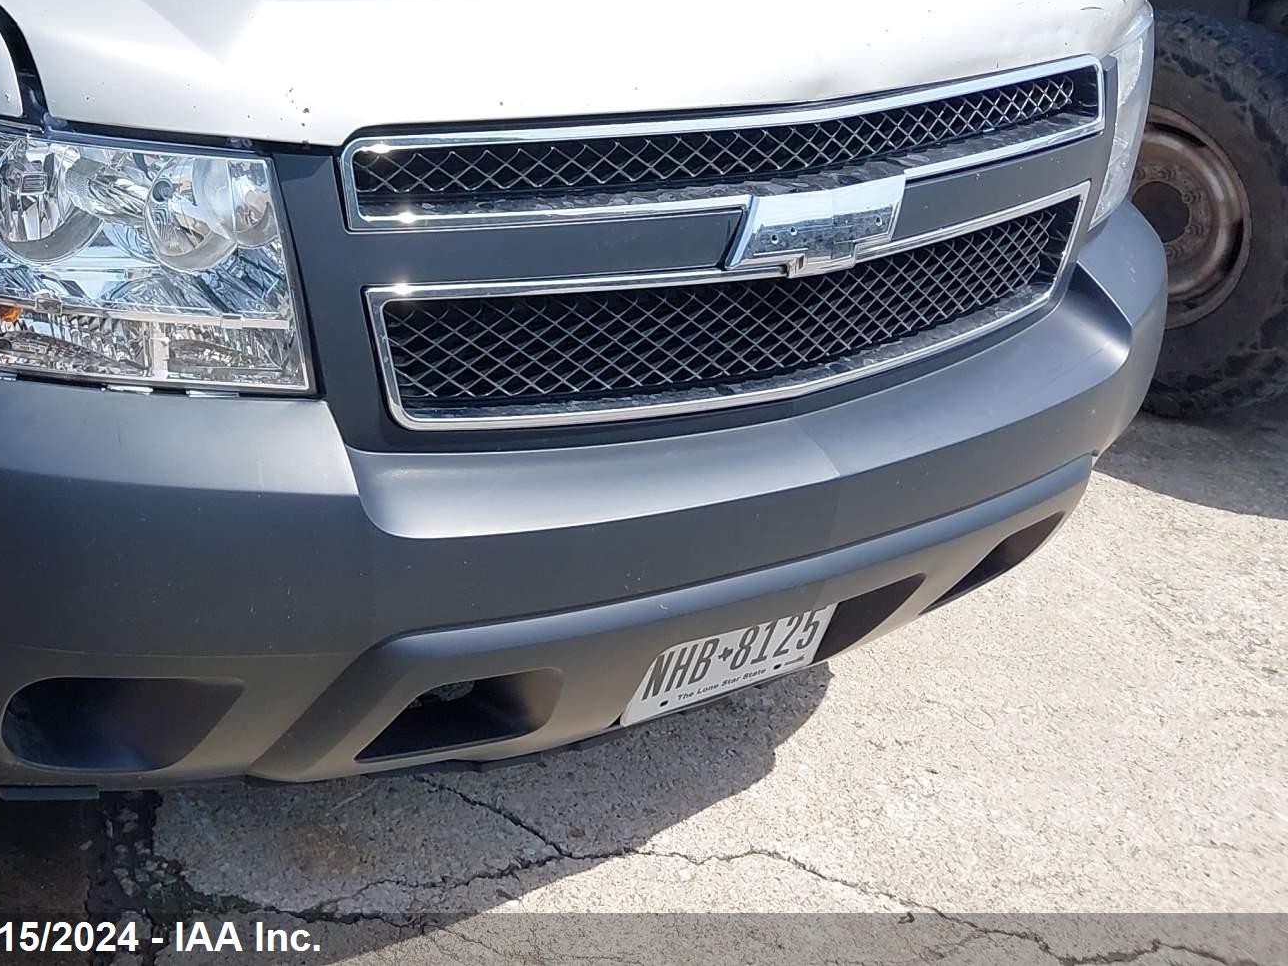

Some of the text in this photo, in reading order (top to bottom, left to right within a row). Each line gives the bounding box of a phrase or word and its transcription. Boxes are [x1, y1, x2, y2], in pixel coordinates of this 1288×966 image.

[640, 609, 825, 702] NHB 8125
[678, 668, 767, 701] The Lone Star State
